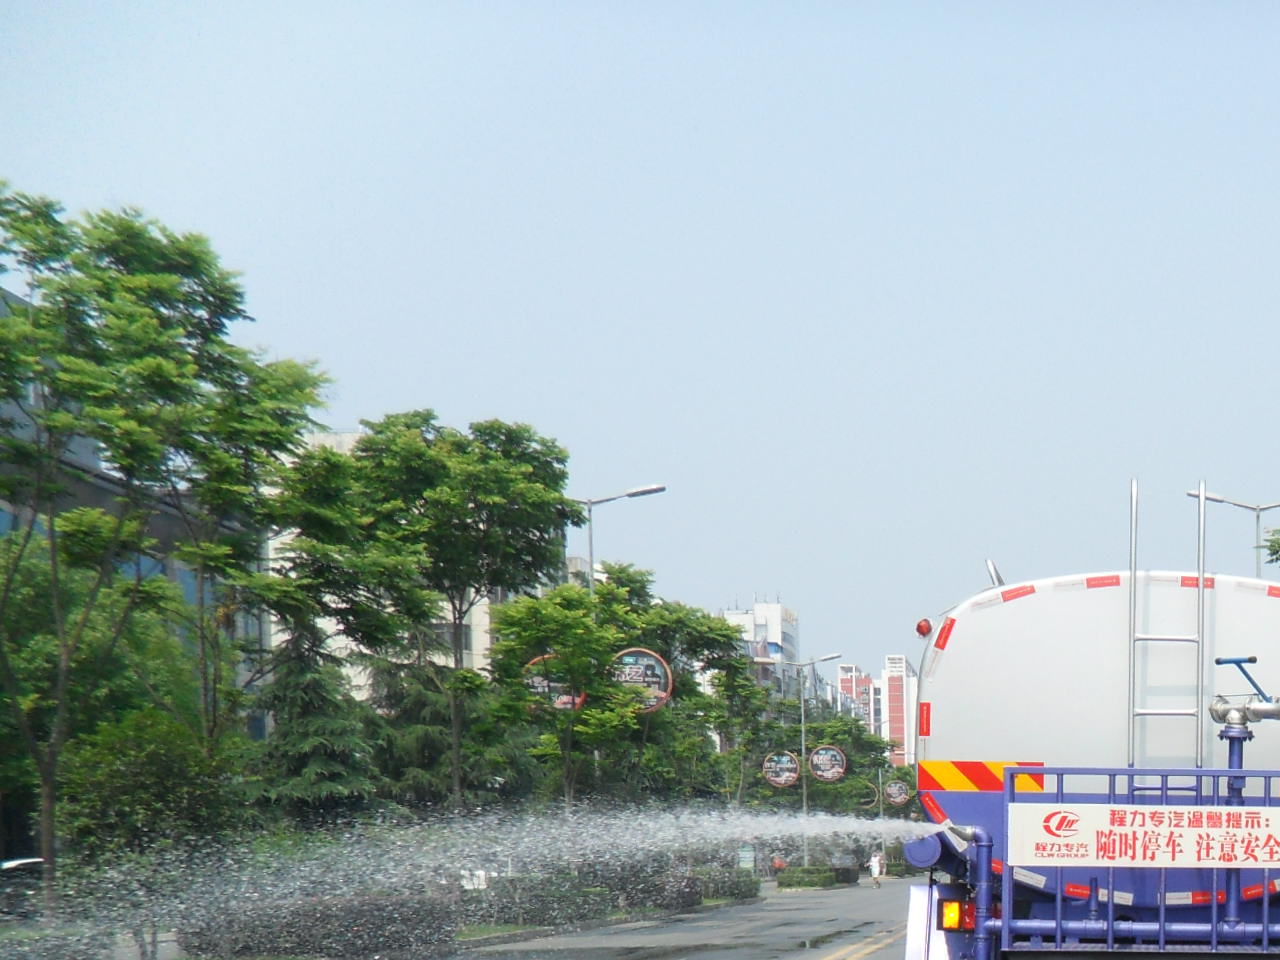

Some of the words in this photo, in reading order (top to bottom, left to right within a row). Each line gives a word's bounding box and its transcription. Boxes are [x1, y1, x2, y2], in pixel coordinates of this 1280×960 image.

[1035, 842, 1089, 852] 程力专汽
[1095, 830, 1184, 863] 随时停车
